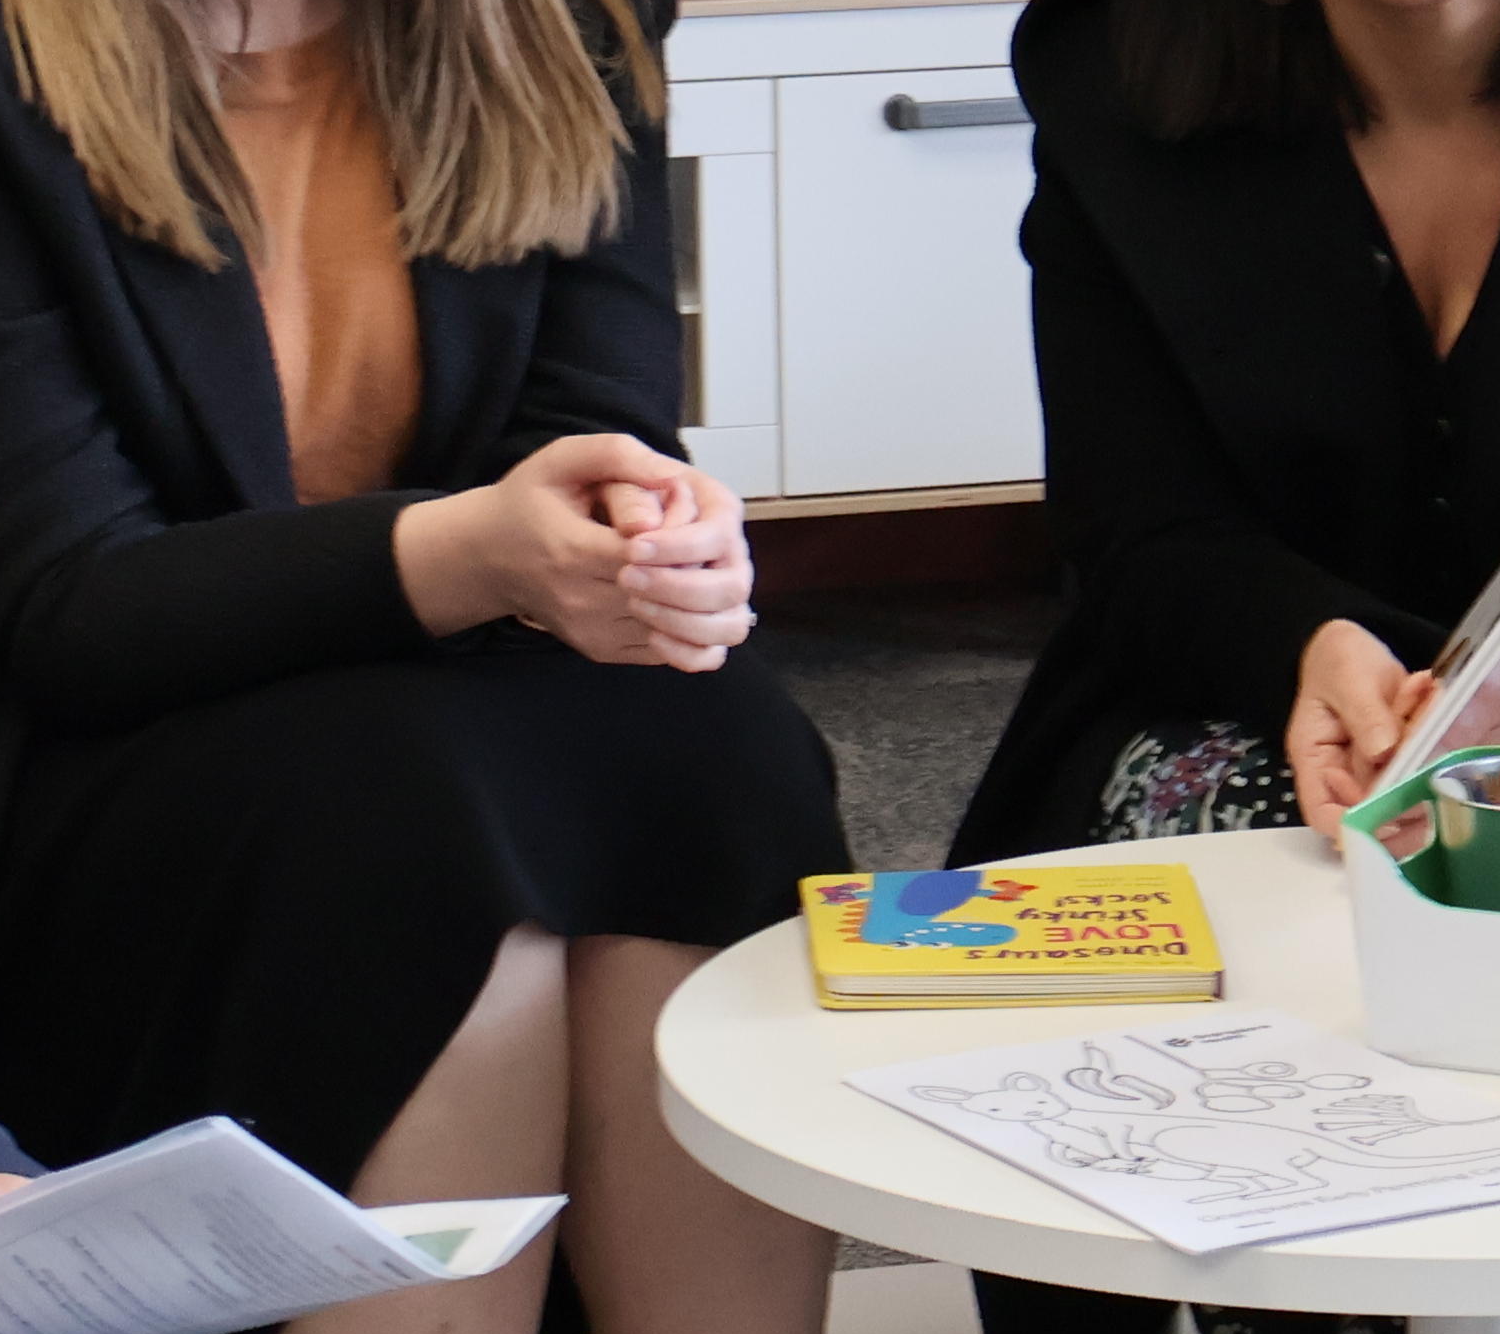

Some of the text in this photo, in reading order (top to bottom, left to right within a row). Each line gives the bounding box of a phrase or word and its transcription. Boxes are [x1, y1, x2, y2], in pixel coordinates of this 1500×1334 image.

[1055, 891, 1172, 907] Socks!
[1014, 908, 1150, 923] Stinky
[1043, 923, 1185, 943] LOVE
[964, 941, 1189, 960] Dinosaurs
